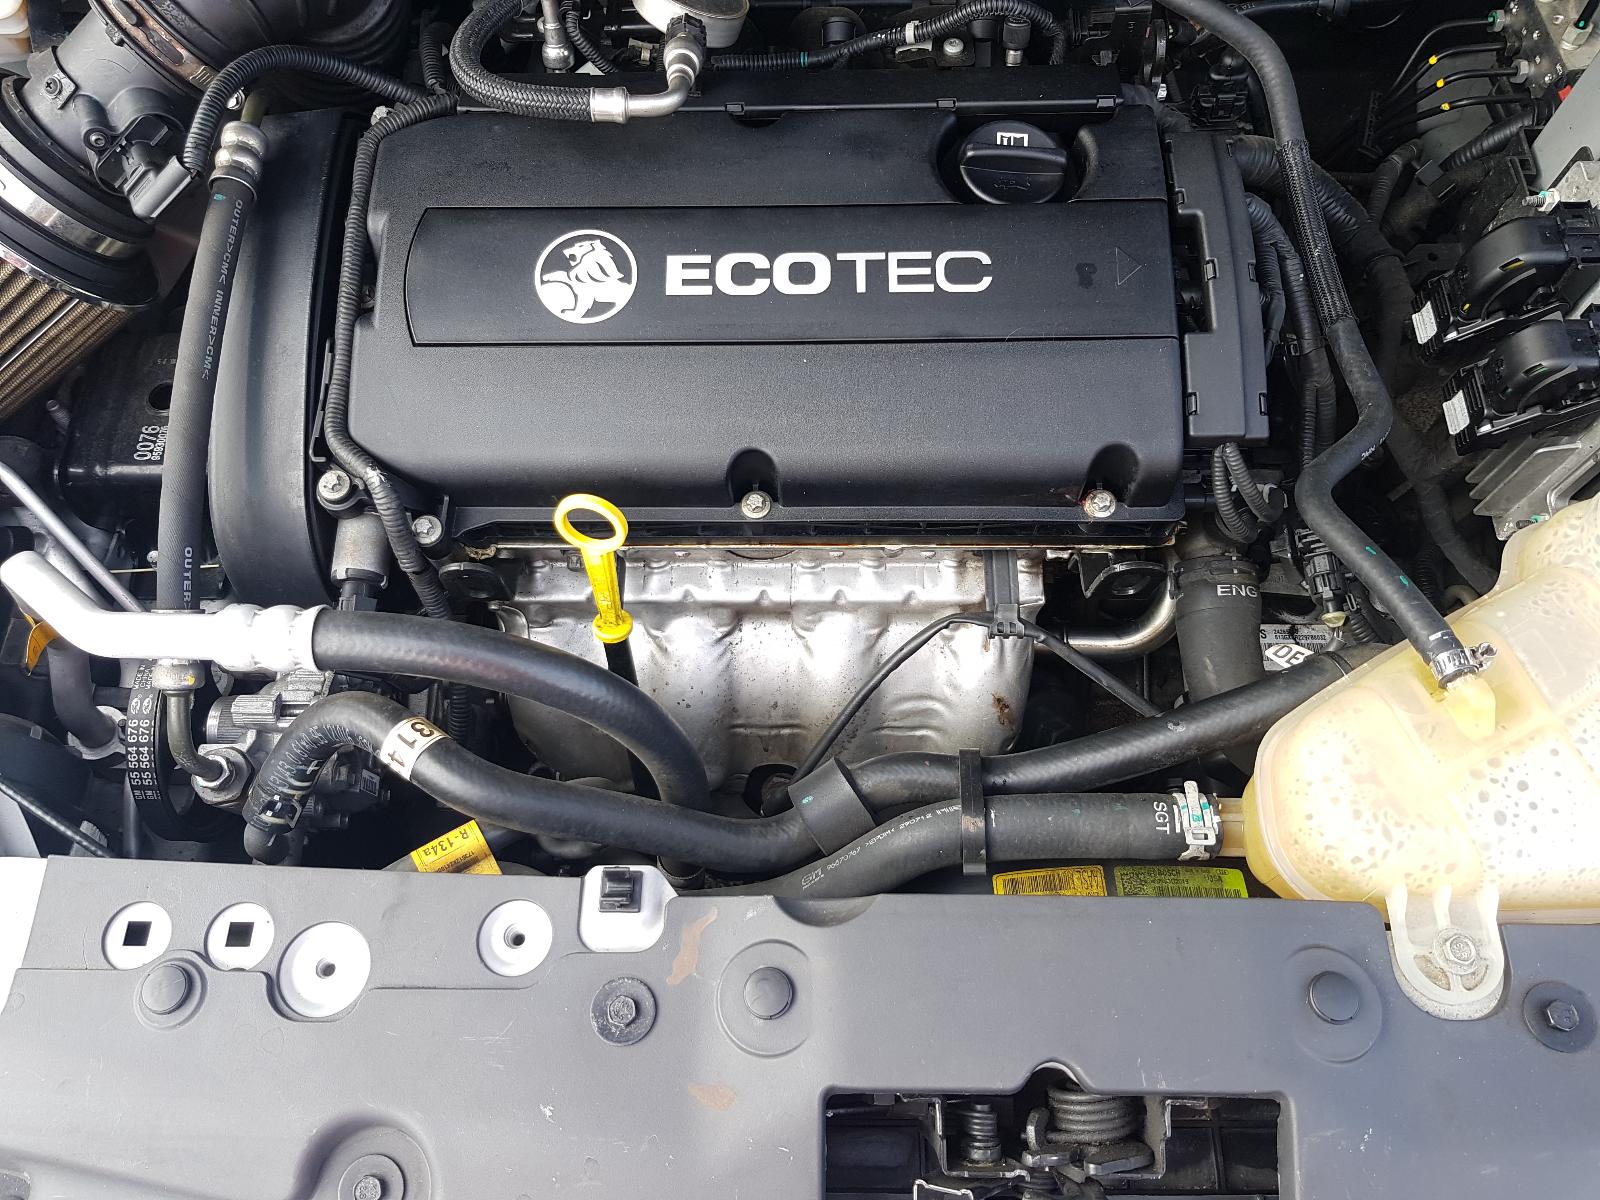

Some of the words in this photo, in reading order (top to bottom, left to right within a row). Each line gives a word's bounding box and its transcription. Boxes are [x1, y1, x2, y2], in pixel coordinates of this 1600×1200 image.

[665, 250, 993, 296] ECOTEC
[133, 425, 160, 461] 0076
[1216, 584, 1258, 598] ENG
[127, 719, 138, 743] 676
[138, 719, 149, 743] 676
[127, 746, 139, 769] 564
[138, 746, 150, 769] 564
[130, 771, 141, 786] 55
[141, 771, 152, 786] 55
[133, 789, 143, 801] GM
[1153, 801, 1170, 835] SGT
[423, 829, 469, 857] R-134a
